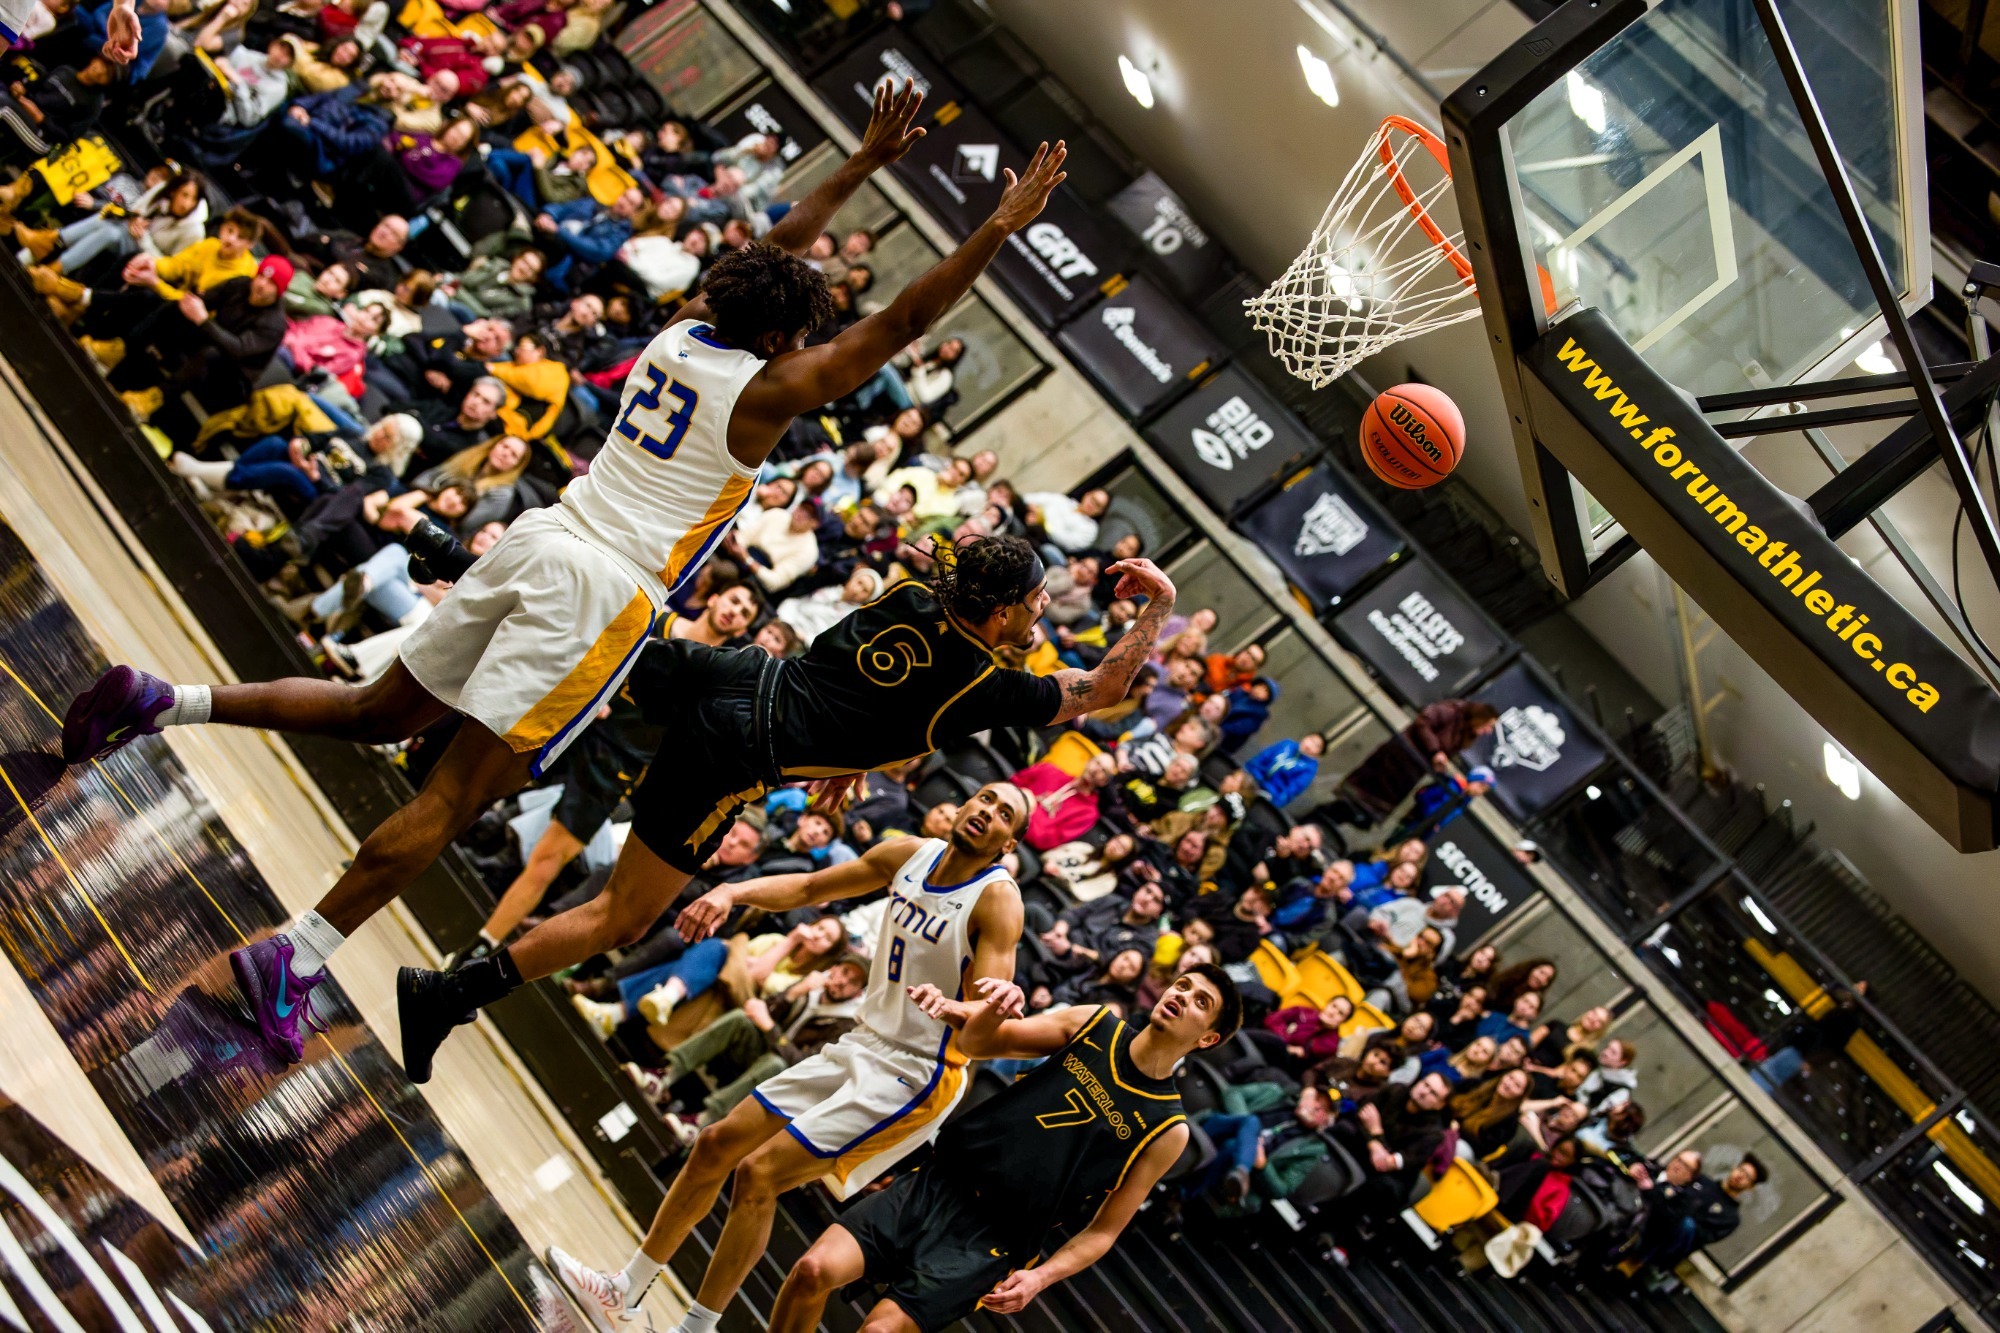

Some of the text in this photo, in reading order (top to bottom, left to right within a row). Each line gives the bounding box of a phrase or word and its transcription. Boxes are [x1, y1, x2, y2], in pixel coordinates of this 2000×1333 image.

[1026, 222, 1098, 279] GRT
[1142, 215, 1183, 256] 10
[1154, 196, 1208, 249] SECTION
[615, 360, 699, 462] 23
[1217, 395, 1274, 450] BIO
[1389, 403, 1442, 464] Wilson
[1371, 431, 1422, 480] EVOLUTION
[1556, 337, 1940, 713] www.forumathletic.ca
[1367, 609, 1439, 682] ROADHOUSE
[1398, 591, 1464, 655] KELSEYS
[856, 624, 932, 687] 6
[1435, 841, 1509, 914] SECTION
[887, 935, 906, 983] 8
[1035, 1087, 1097, 1129] 7
[1062, 1053, 1131, 1140] WATERLOO
